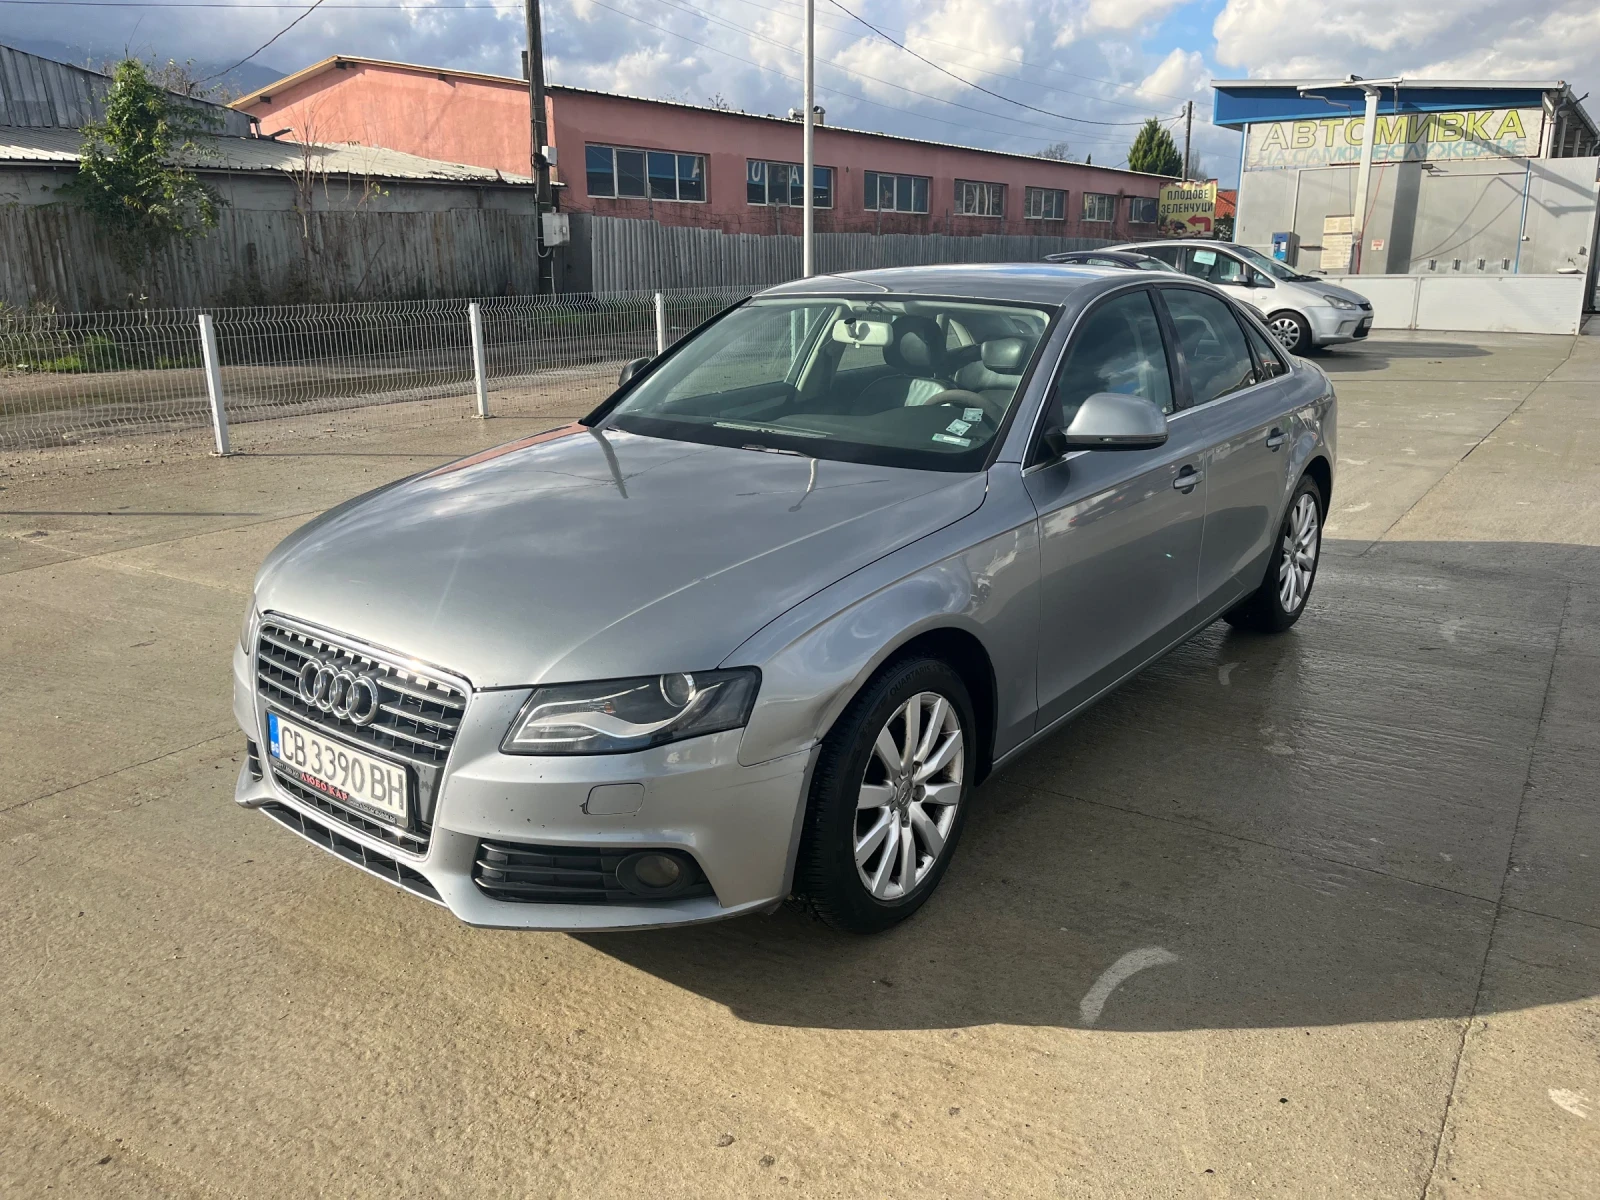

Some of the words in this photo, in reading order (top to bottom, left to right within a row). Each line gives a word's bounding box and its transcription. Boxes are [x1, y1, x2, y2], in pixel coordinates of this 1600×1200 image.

[1260, 109, 1526, 151] АВТОМИВКА
[1161, 202, 1213, 214] ЗЕЛЕНЧУЦИ
[1167, 189, 1209, 200] ПЛОДОВЕ
[281, 726, 307, 767] CB
[312, 740, 365, 793] 3390
[370, 763, 404, 811] BH
[301, 771, 327, 792] ЛЮБО
[328, 785, 349, 801] КАР
